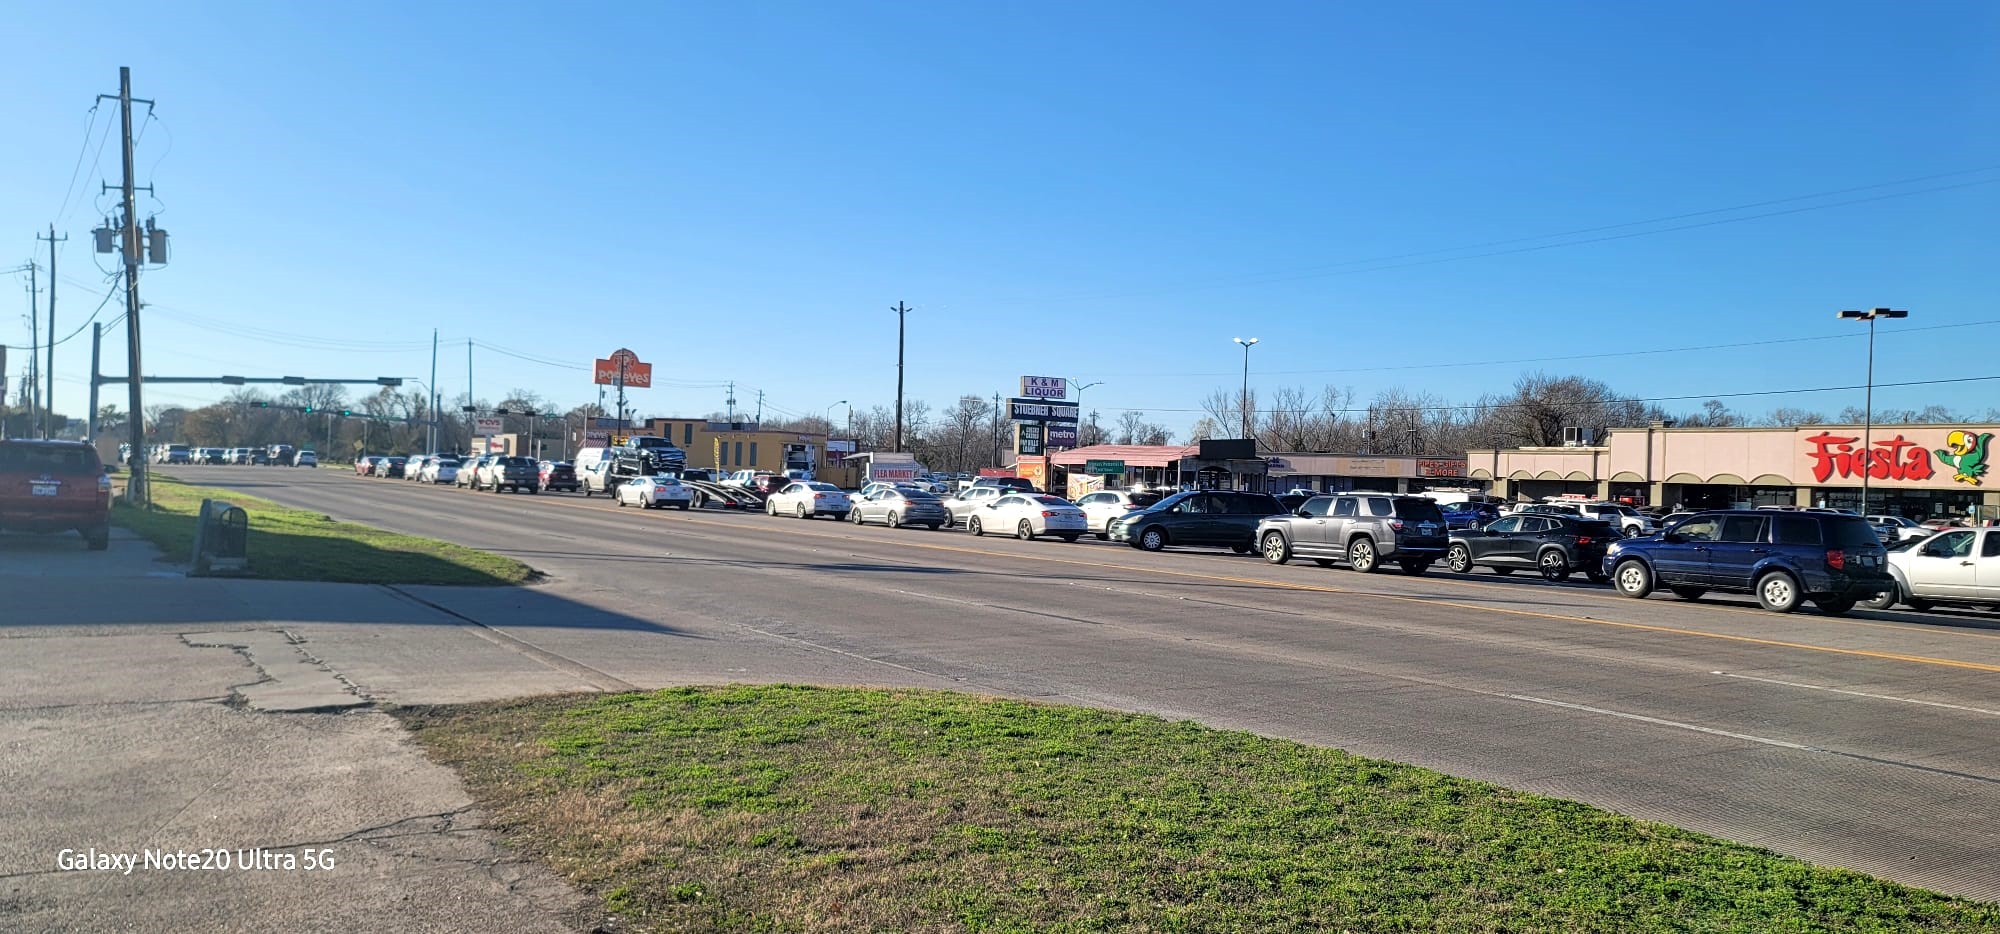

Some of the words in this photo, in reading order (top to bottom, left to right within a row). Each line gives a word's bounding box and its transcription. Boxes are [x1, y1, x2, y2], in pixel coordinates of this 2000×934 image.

[1031, 377, 1038, 386] K
[1041, 378, 1048, 387] &
[1051, 379, 1059, 388] M
[1025, 387, 1064, 398] LIQUOR
[1014, 404, 1049, 417] STUEBNER
[1052, 406, 1078, 418] SQUARE
[1050, 430, 1075, 440] metro
[1805, 432, 1933, 483] Fiesta
[874, 469, 888, 479] FLEA
[889, 469, 913, 479] MARKET
